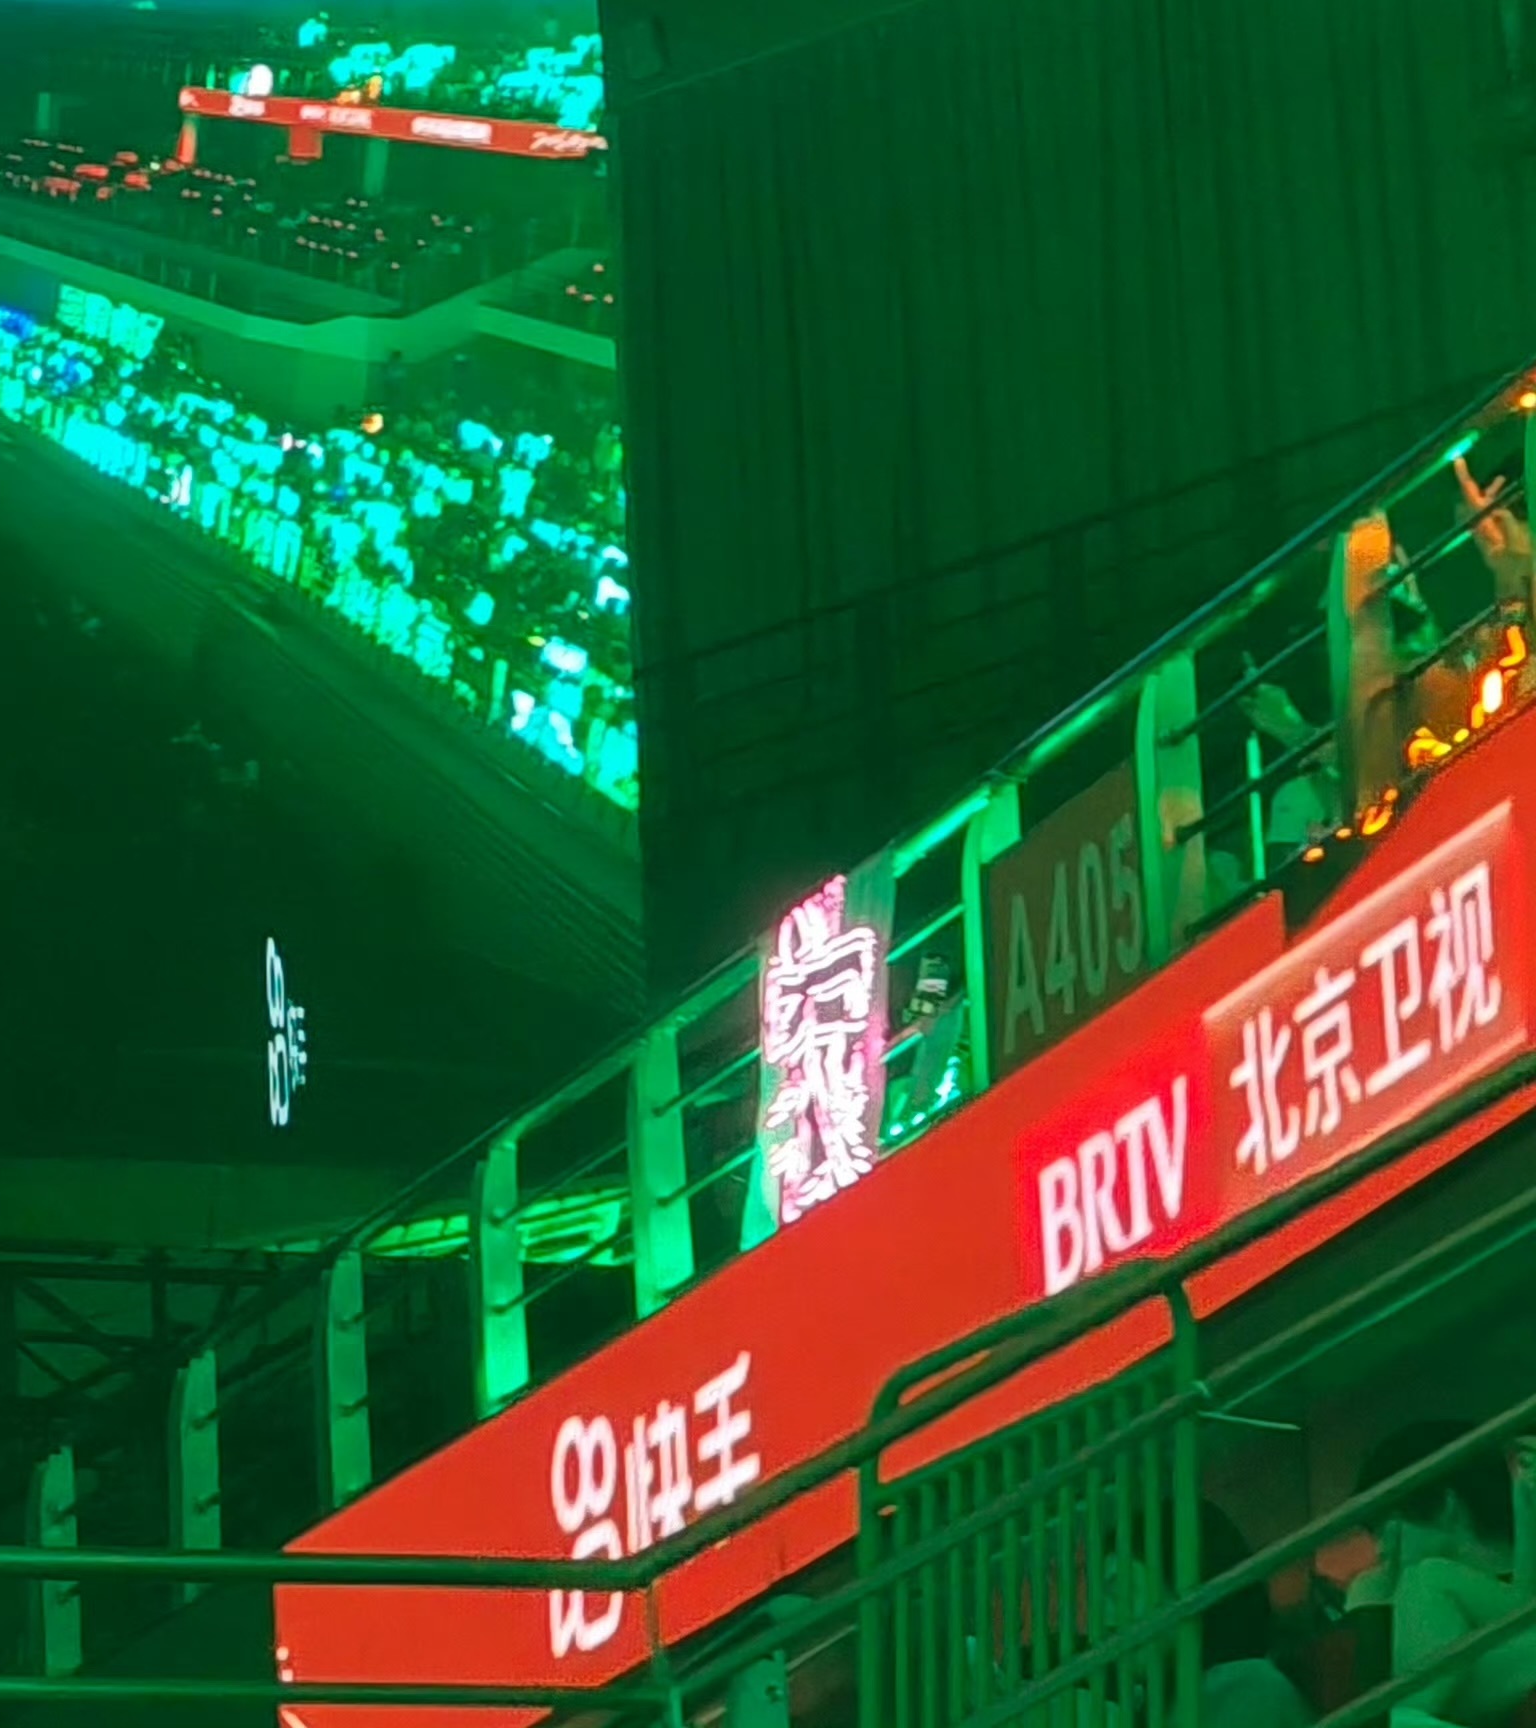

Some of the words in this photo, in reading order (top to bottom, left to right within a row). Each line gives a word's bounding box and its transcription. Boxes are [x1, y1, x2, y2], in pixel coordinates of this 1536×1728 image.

[1004, 812, 1143, 1055] A405
[1229, 860, 1502, 1176] 北京卫视
[1038, 1075, 1188, 1297] BRTV
